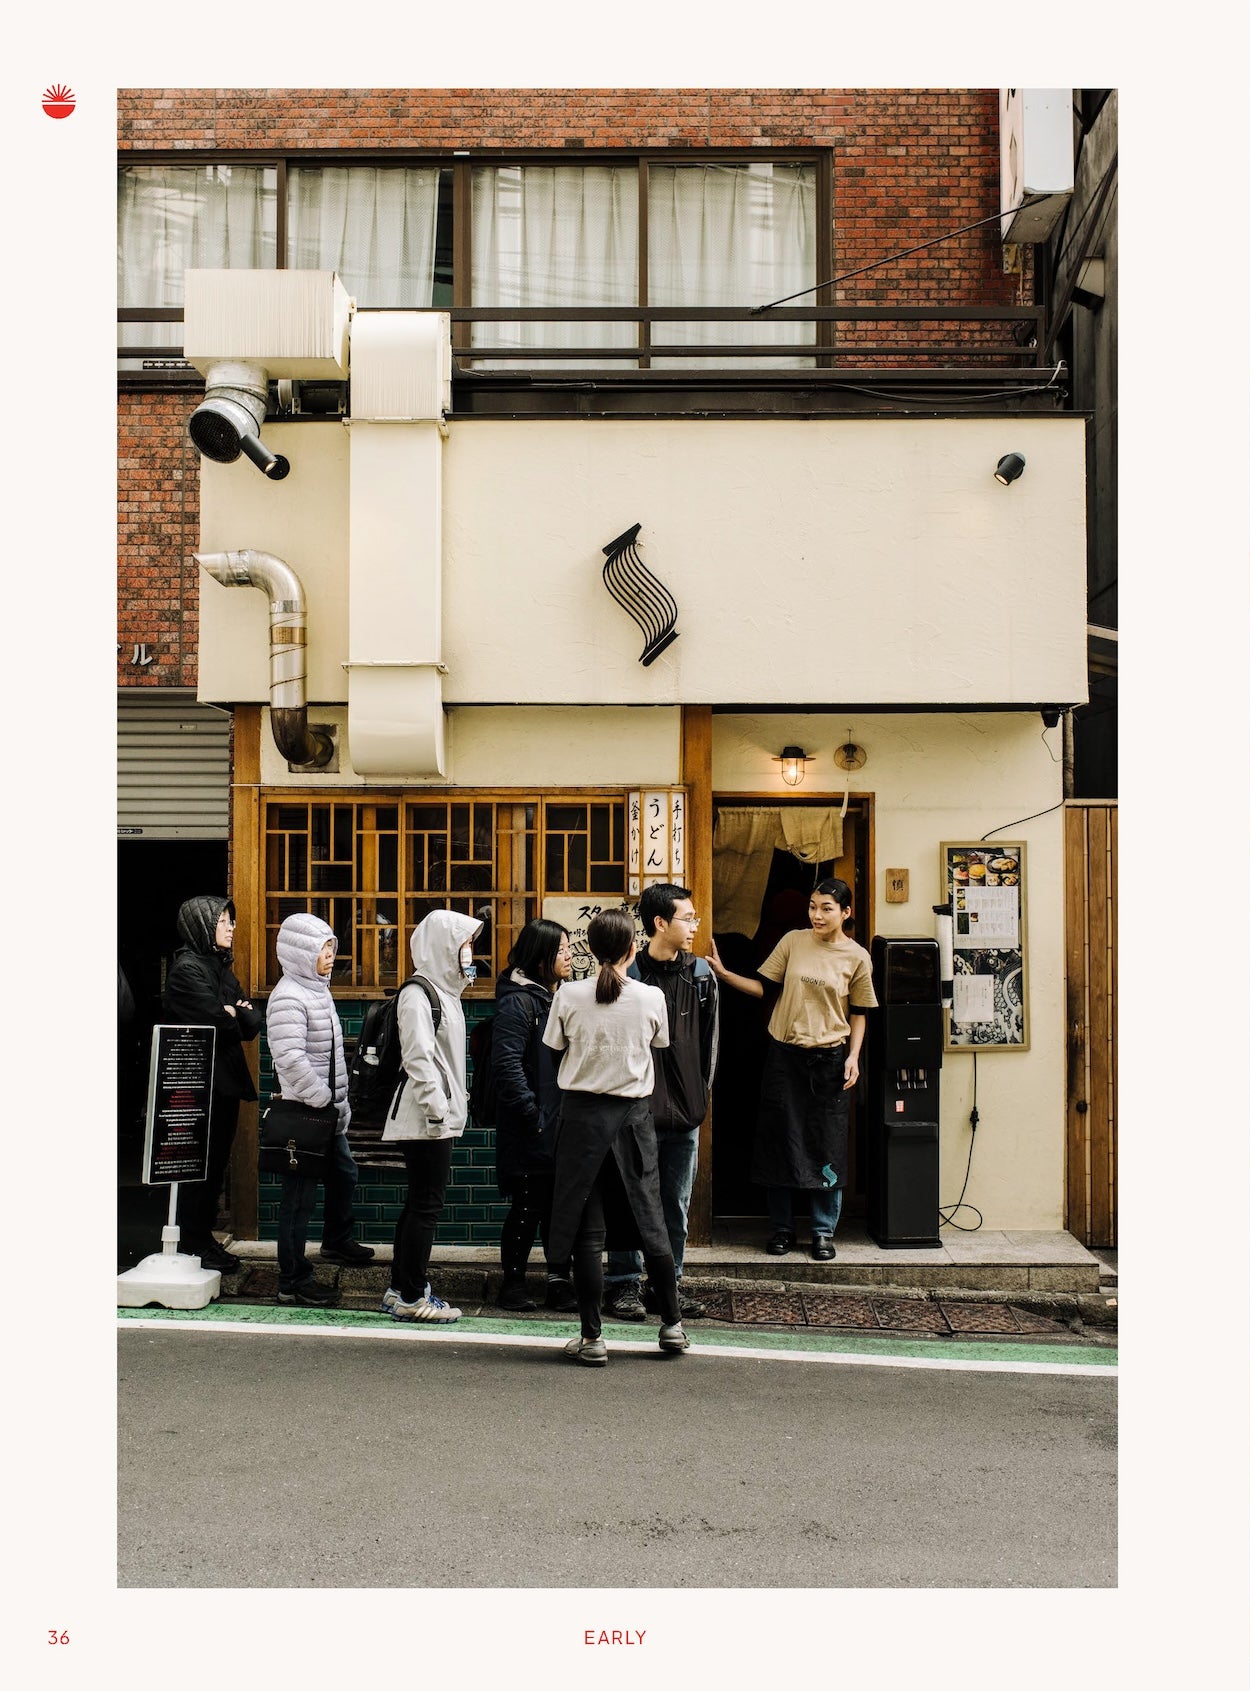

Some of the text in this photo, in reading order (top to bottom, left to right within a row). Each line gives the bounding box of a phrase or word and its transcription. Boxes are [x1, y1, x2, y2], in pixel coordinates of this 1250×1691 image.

[118, 643, 154, 666] ル
[630, 800, 640, 865] 釜かけ
[647, 798, 665, 867] うどん
[672, 799, 682, 866] 手打ち
